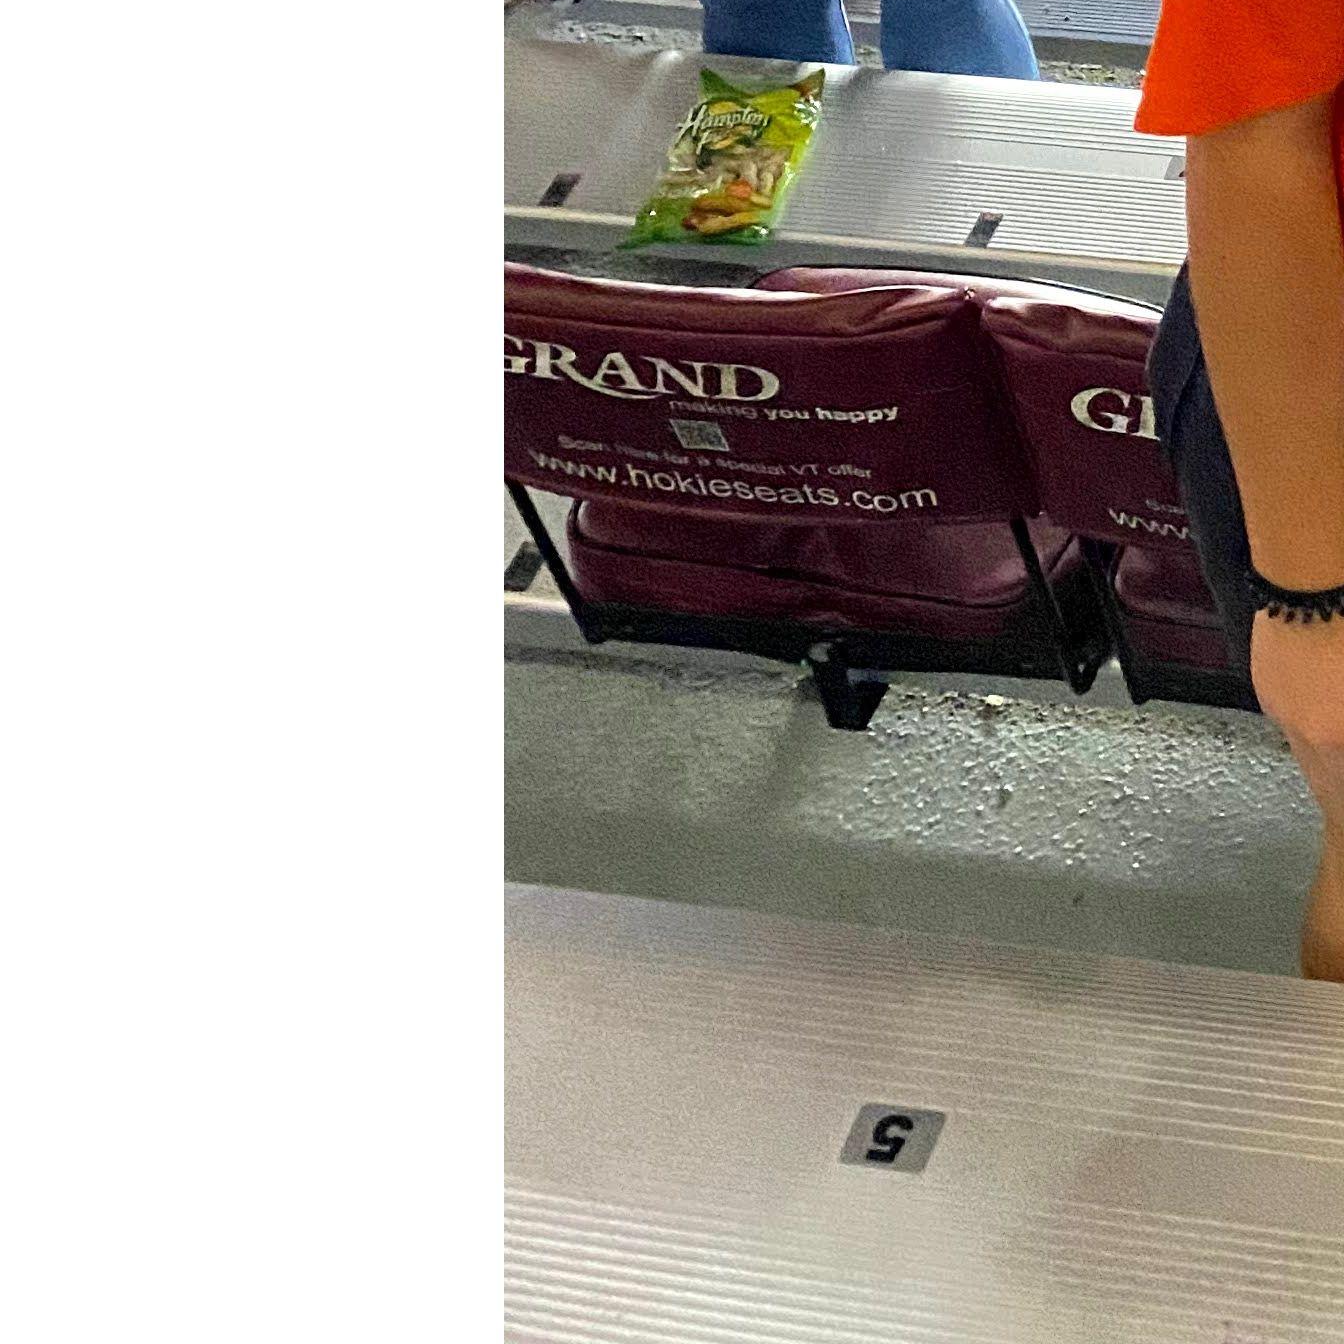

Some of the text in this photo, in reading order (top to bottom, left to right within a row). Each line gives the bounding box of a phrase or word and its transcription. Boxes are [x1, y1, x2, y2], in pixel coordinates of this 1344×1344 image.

[764, 407, 809, 421] you
[814, 406, 899, 424] happy
[526, 448, 939, 513] www.hokieseats.com
[865, 1114, 914, 1164] 5
